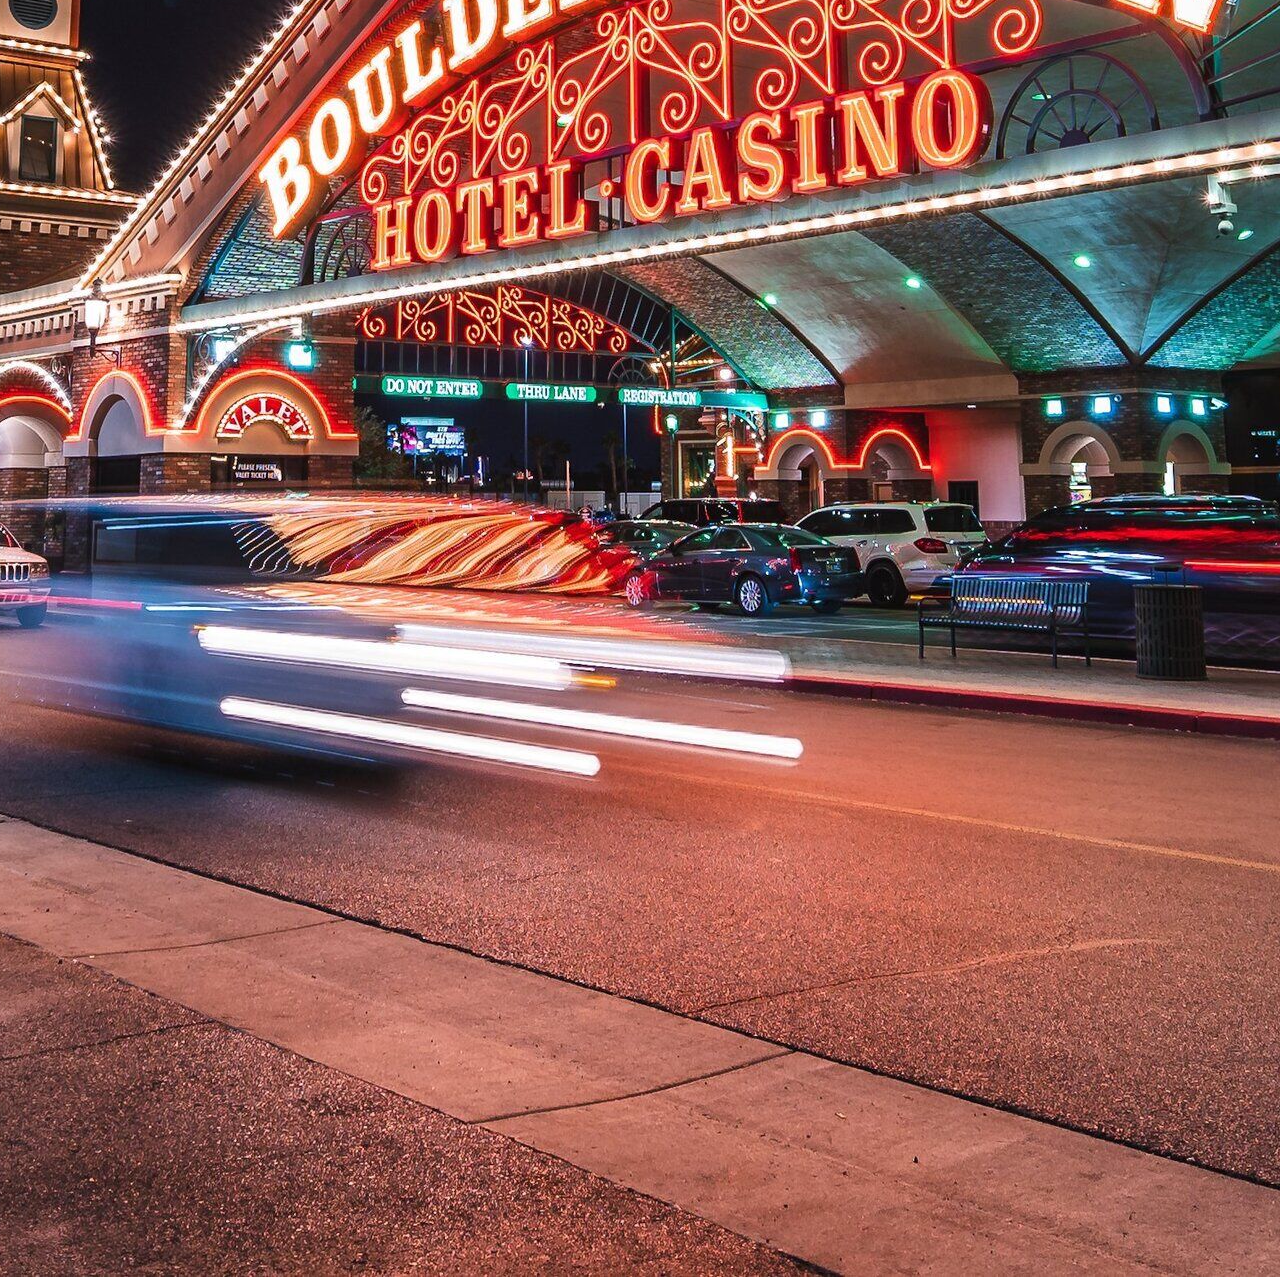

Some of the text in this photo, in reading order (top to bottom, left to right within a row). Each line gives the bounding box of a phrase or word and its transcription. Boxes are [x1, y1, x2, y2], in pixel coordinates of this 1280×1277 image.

[370, 68, 980, 271] HOTEL CASINO
[386, 378, 479, 396] DO NOT ENTER
[517, 384, 587, 400] THRU LANE
[623, 389, 697, 405] REGISTRATION
[224, 398, 308, 433] VALET
